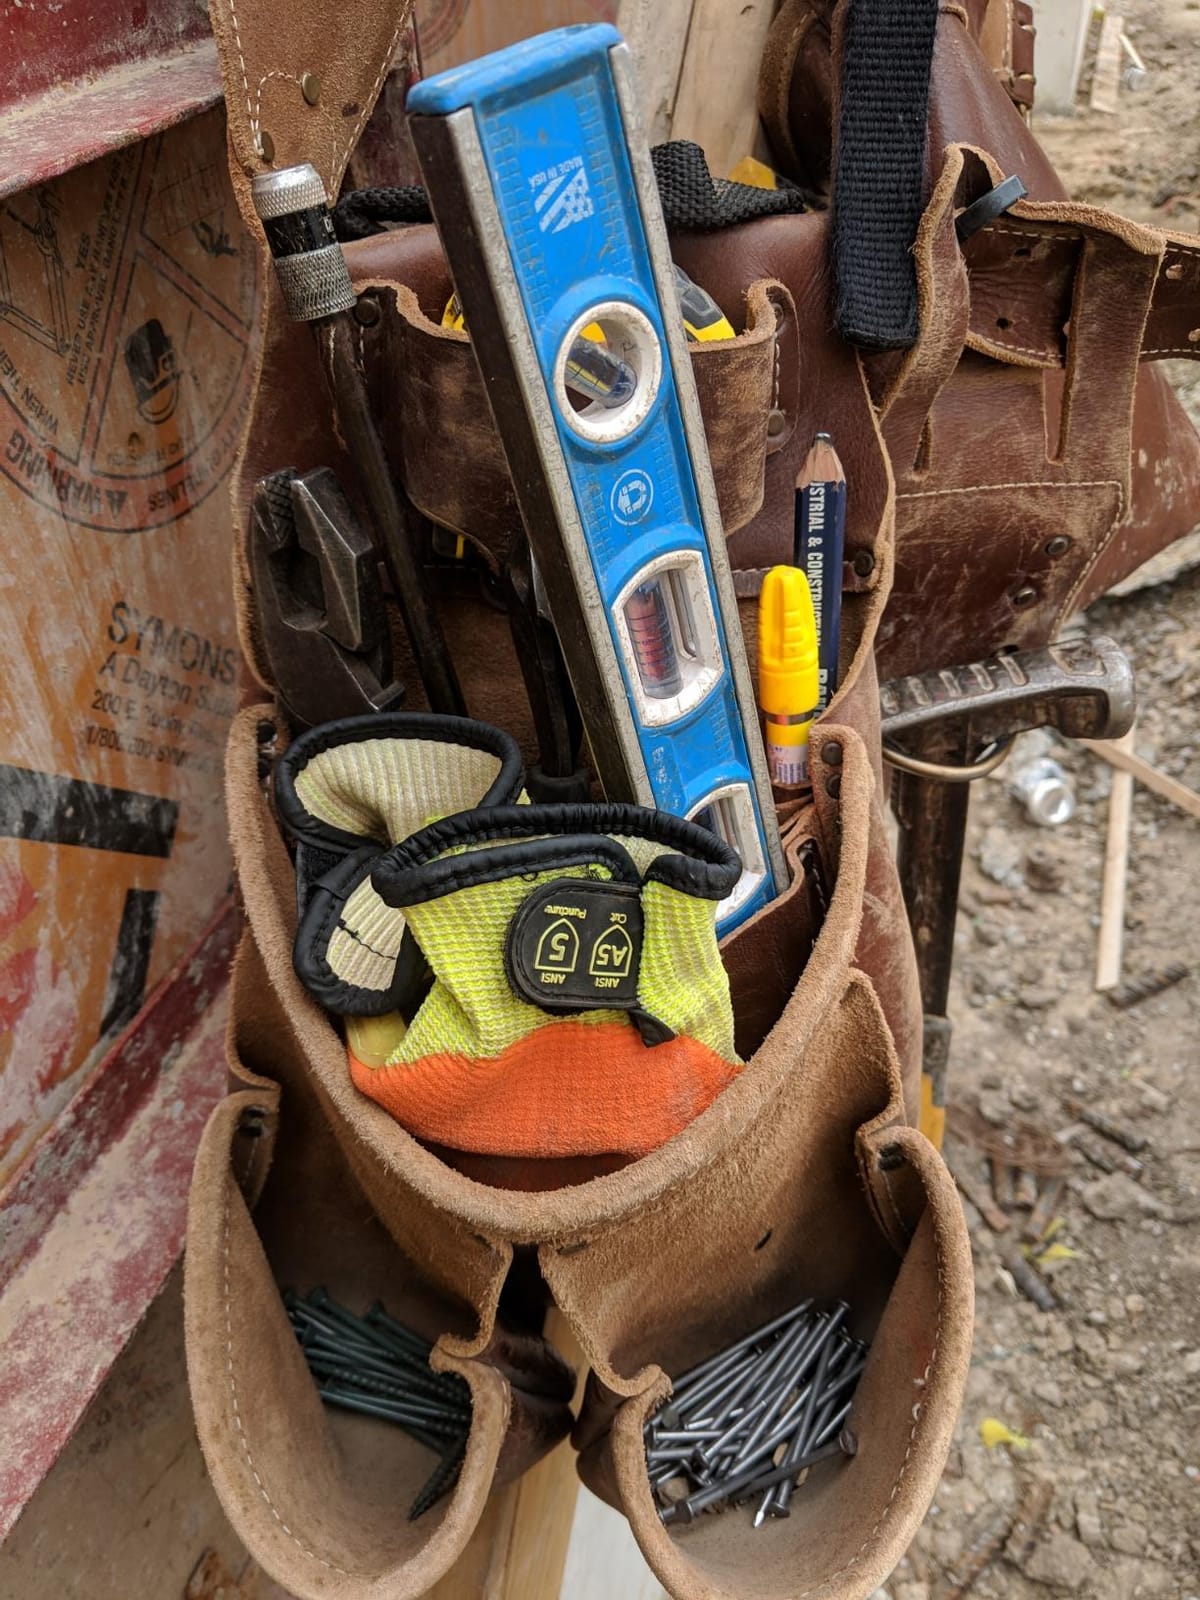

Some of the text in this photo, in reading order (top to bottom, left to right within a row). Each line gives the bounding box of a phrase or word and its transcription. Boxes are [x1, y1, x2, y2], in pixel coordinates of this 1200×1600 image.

[528, 155, 583, 188] MADE IN USA
[74, 232, 91, 269] YES
[807, 536, 824, 548] &
[108, 601, 236, 686] SYMONS
[99, 650, 118, 678] A
[122, 657, 192, 705] Dayton
[544, 904, 588, 920] Puncture
[609, 912, 628, 925] Cut
[548, 932, 570, 961] 5
[596, 943, 628, 967] A5
[541, 972, 567, 985] ANSI
[594, 977, 620, 988] ANSI
